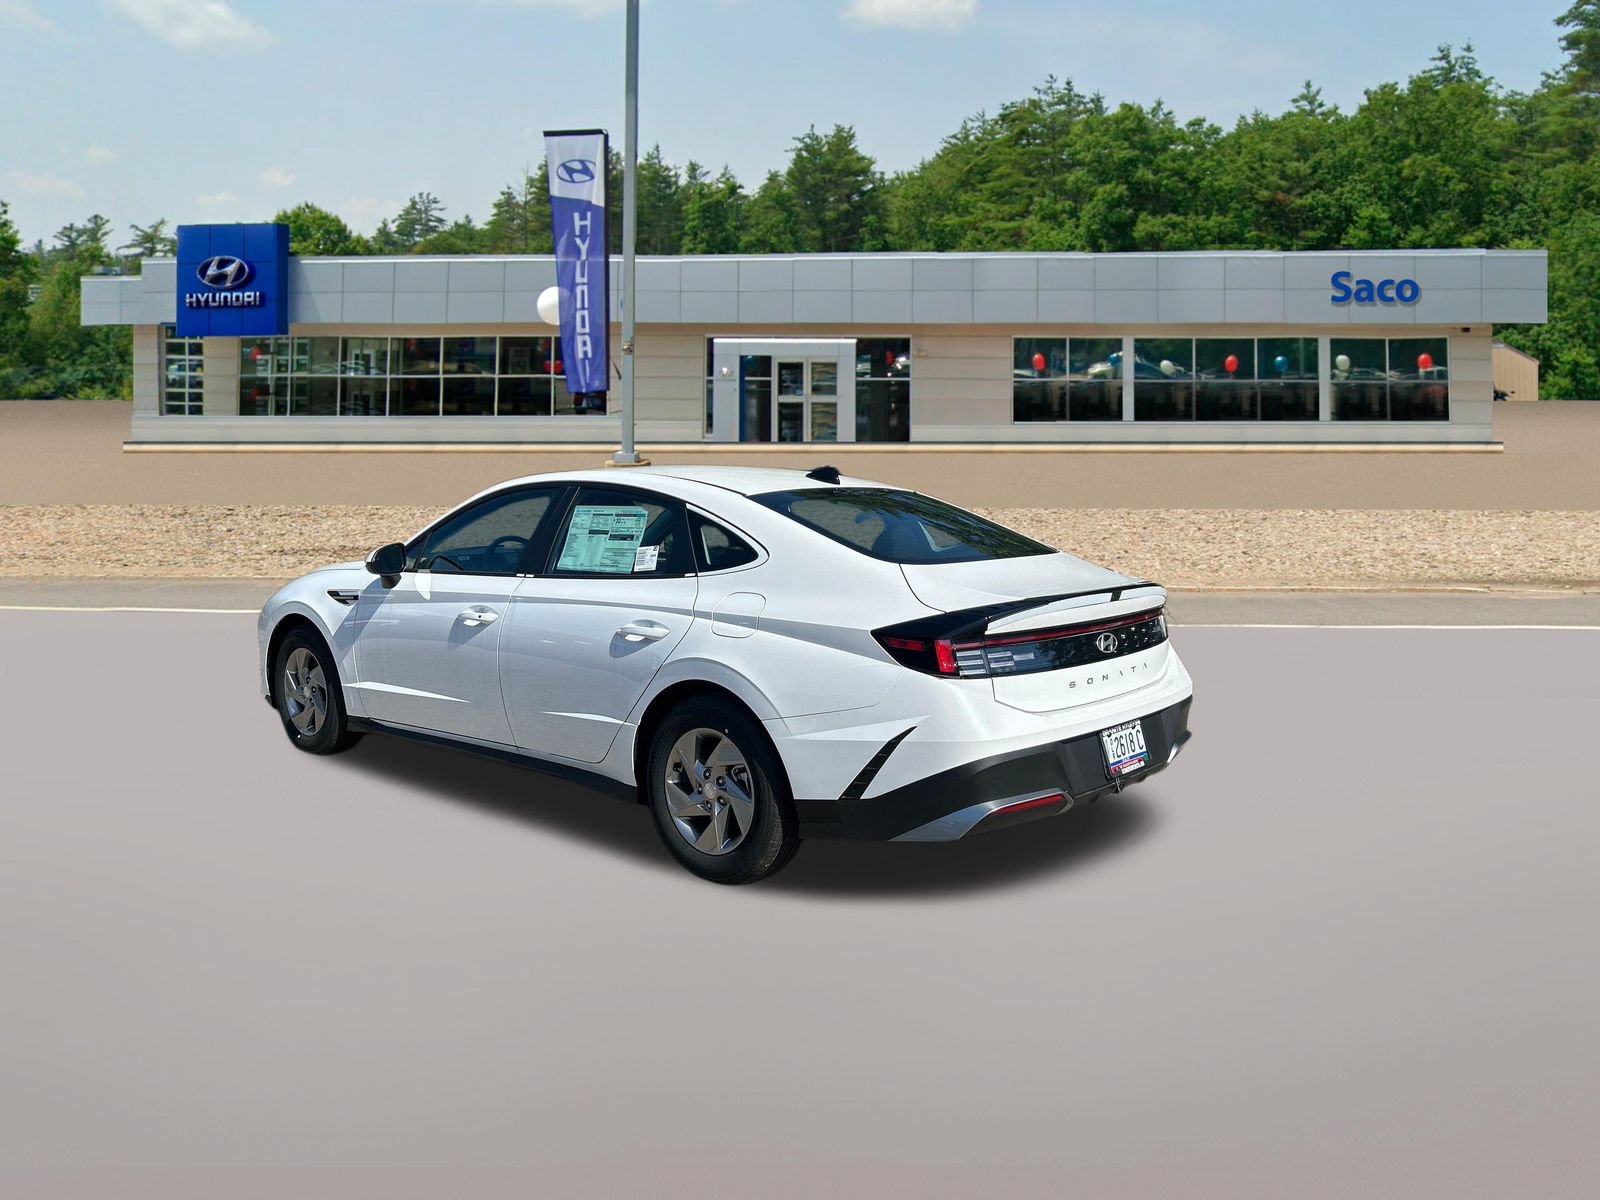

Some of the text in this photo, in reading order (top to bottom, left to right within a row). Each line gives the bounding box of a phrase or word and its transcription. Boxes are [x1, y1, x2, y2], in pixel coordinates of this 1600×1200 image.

[185, 291, 261, 307] HYUNDAI
[573, 211, 592, 384] HYUNDAI
[1330, 270, 1420, 303] Saco
[1068, 662, 1148, 689] SONATA
[1114, 732, 1135, 758] 2618
[1136, 730, 1144, 750] C
